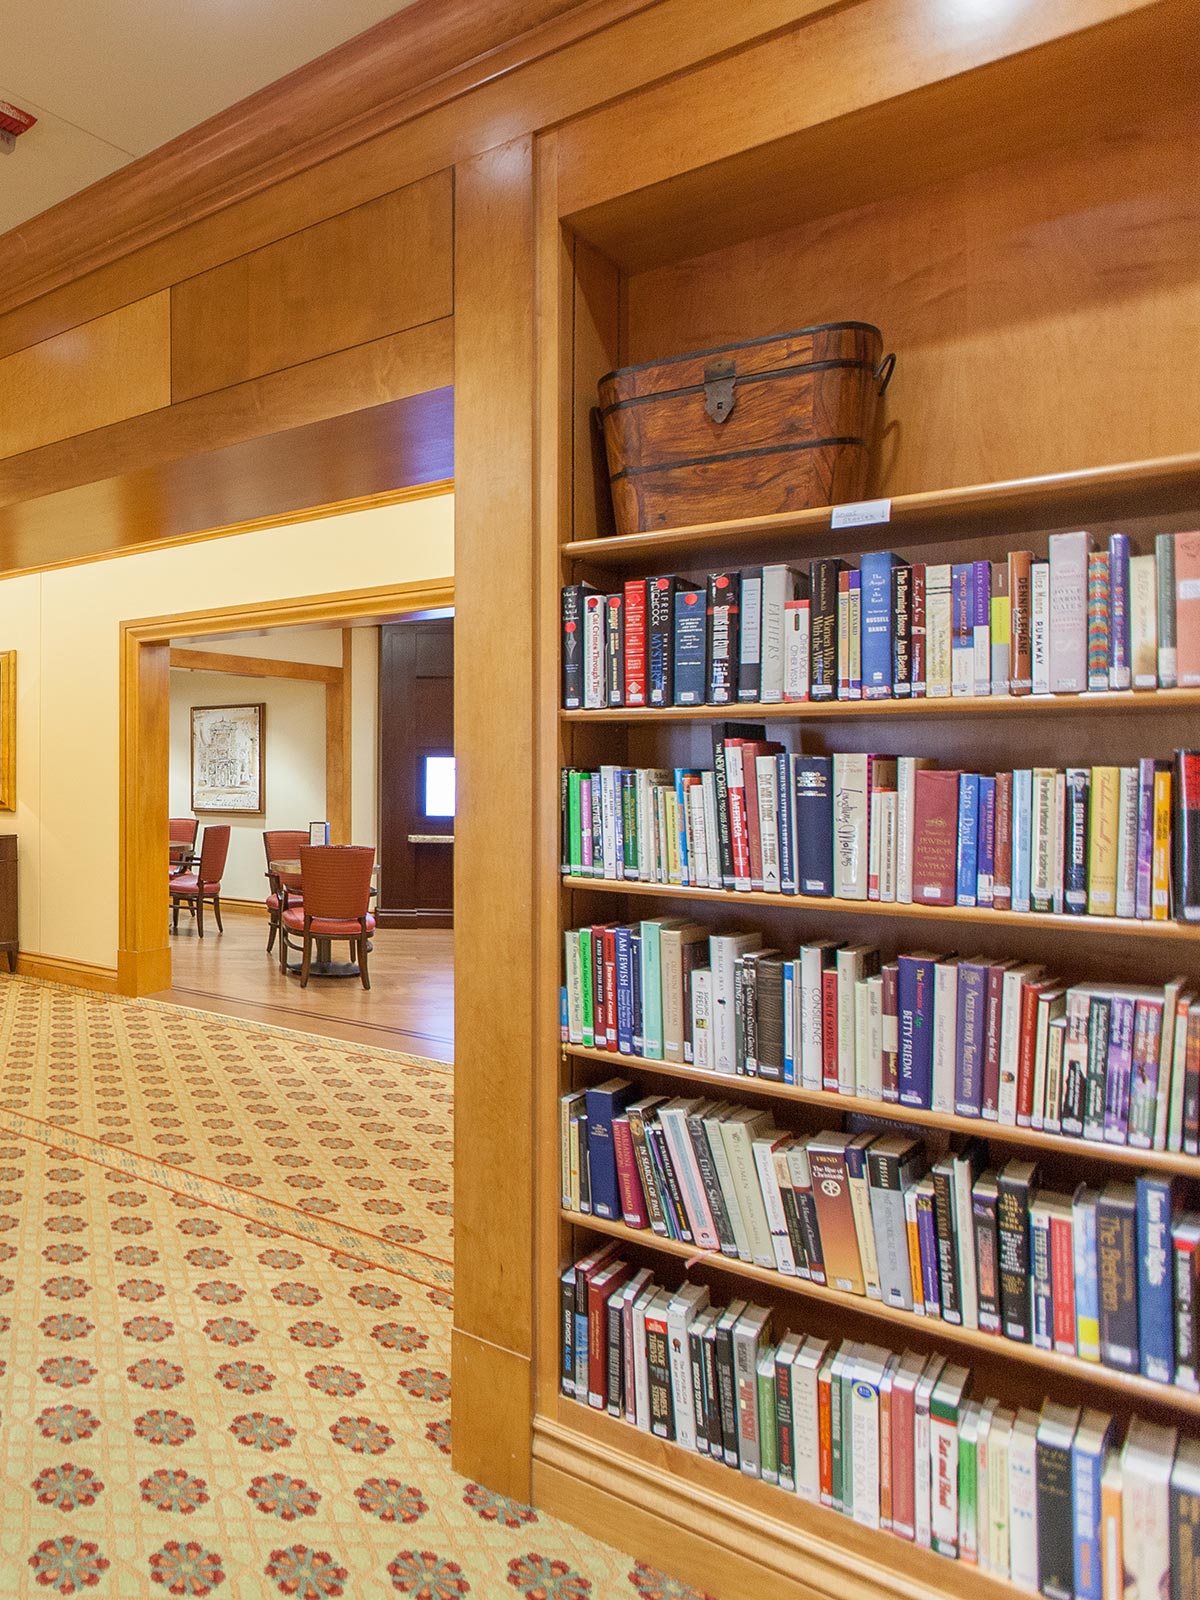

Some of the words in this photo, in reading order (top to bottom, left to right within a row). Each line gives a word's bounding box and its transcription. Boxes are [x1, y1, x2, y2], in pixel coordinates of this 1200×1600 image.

[897, 570, 908, 584] The
[660, 587, 669, 621] LFRED
[895, 586, 907, 614] Burning
[1018, 577, 1027, 614] DENNIS
[592, 613, 600, 627] Cat
[812, 615, 823, 635] With
[850, 593, 859, 636] BOULEVARD
[897, 615, 907, 636] House
[592, 628, 600, 650] Crimes
[768, 603, 780, 660] FATHERS
[813, 637, 823, 649] the
[823, 614, 834, 646] Women
[1018, 618, 1027, 655] LEHANE
[1035, 621, 1044, 665] RUNAWAY
[651, 633, 661, 683] MYSTERY
[823, 648, 834, 668] Who
[897, 640, 907, 654] Ann
[590, 651, 600, 679] Through
[964, 784, 974, 809] Stars
[731, 793, 742, 838] AMERICA
[962, 818, 974, 845] David
[619, 937, 627, 952] AM
[618, 953, 629, 986] JEWISH
[916, 968, 924, 981] The
[695, 991, 704, 1015] FREUD
[903, 1009, 912, 1037] BETTY
[747, 1037, 755, 1058] GHOST
[903, 1039, 912, 1079] FRIEDAN
[639, 1146, 648, 1156] IN
[659, 1146, 674, 1177] UNHEALED
[640, 1157, 653, 1186] SEARCH
[698, 1158, 714, 1187] Little
[790, 1157, 803, 1184] BORG
[645, 1187, 655, 1198] OF
[647, 1199, 660, 1218] PAUL
[564, 1310, 572, 1324] OUR
[564, 1325, 572, 1345] CHOICE
[778, 1368, 788, 1397] STIFF
